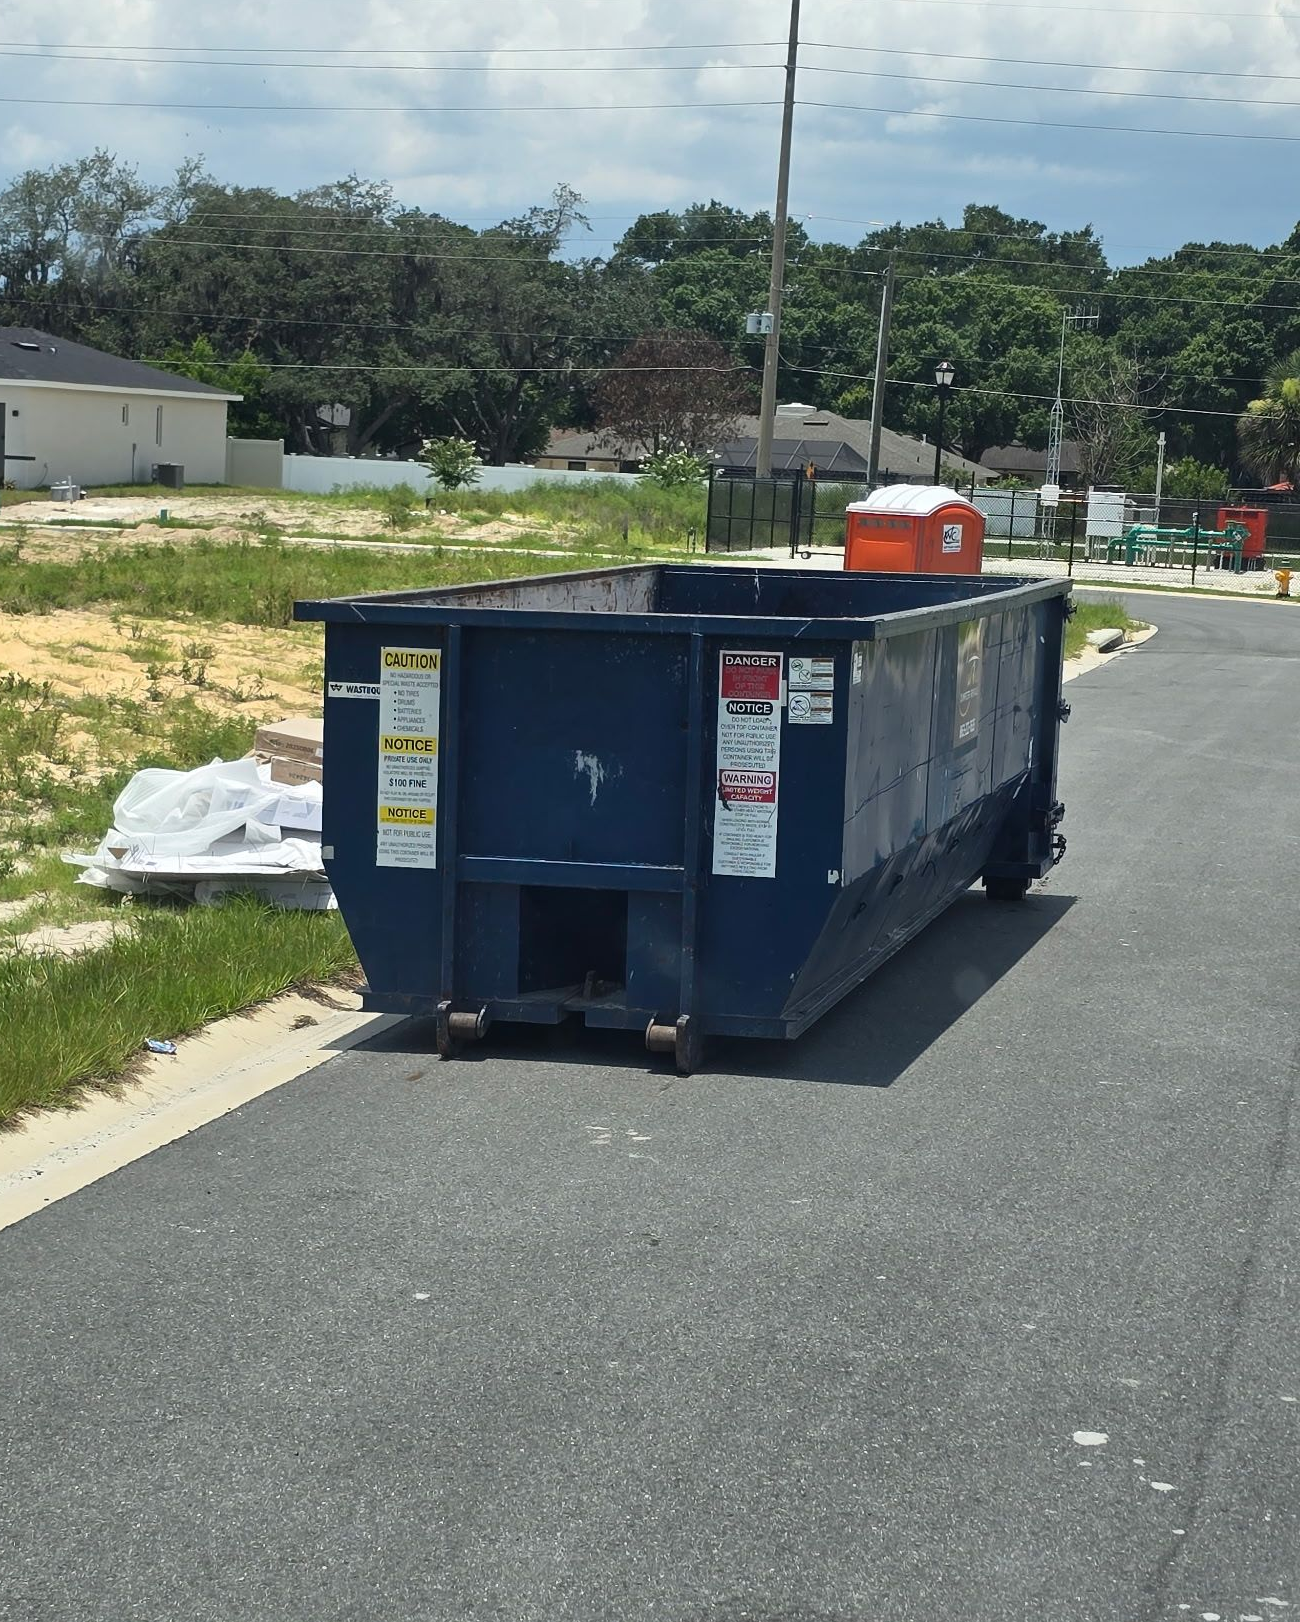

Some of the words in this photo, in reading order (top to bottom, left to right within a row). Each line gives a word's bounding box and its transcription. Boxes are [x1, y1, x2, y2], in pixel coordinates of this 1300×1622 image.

[385, 653, 438, 669] CAUTION
[726, 656, 777, 667] DANGER
[728, 703, 771, 713] NOTICE
[385, 738, 433, 751] NOTICE
[384, 755, 405, 763] PRIVATE
[389, 777, 407, 787] $100
[409, 779, 427, 788] FINE
[724, 774, 772, 785] WARNING
[388, 808, 426, 819] NOTICE
[393, 829, 402, 837] FOR
